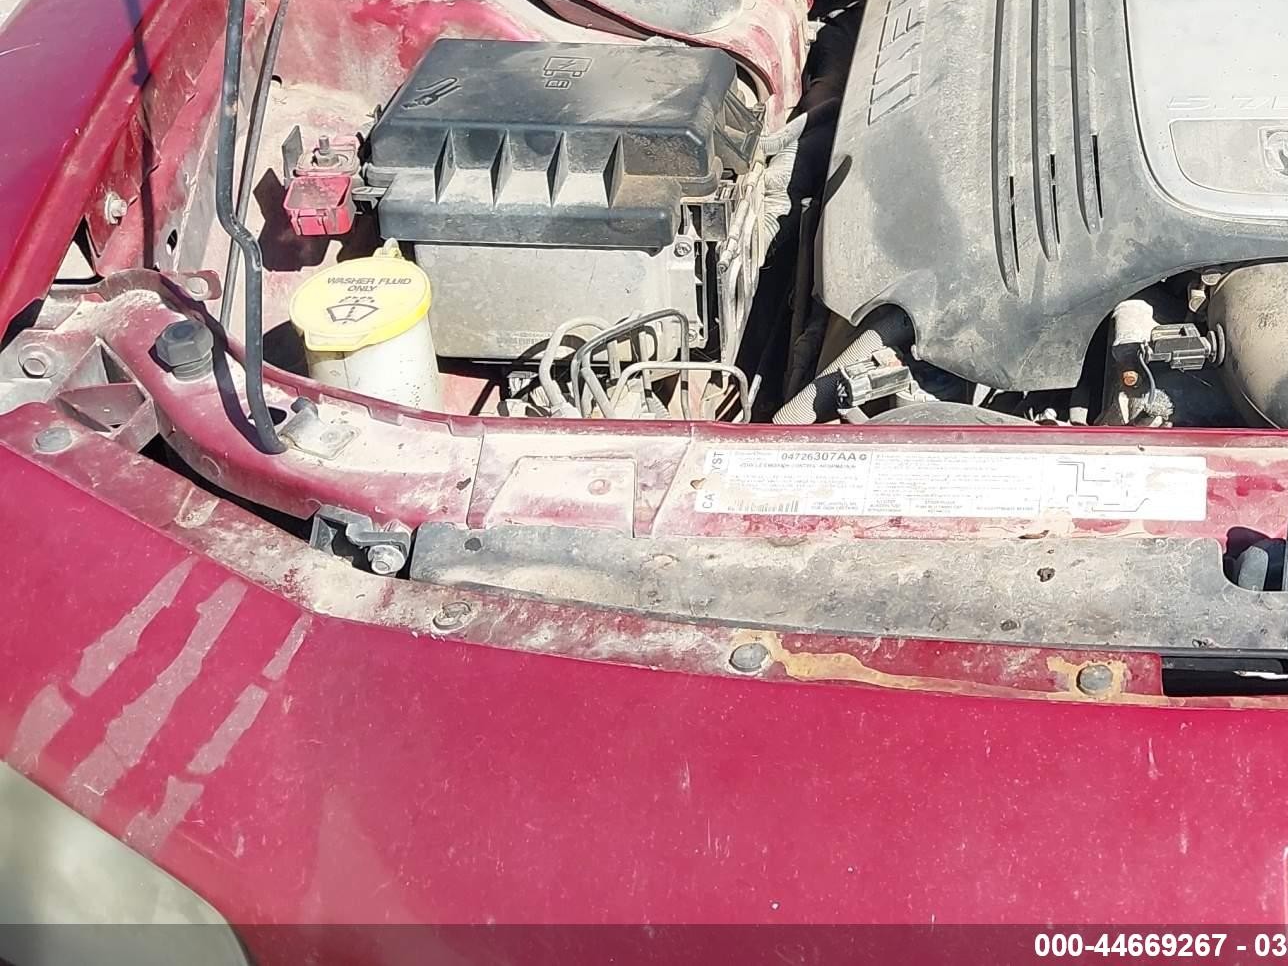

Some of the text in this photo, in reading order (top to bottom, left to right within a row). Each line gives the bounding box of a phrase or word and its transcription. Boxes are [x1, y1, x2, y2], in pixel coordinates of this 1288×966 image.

[327, 277, 412, 285] WASHER FLUID
[702, 451, 725, 509] CAYST
